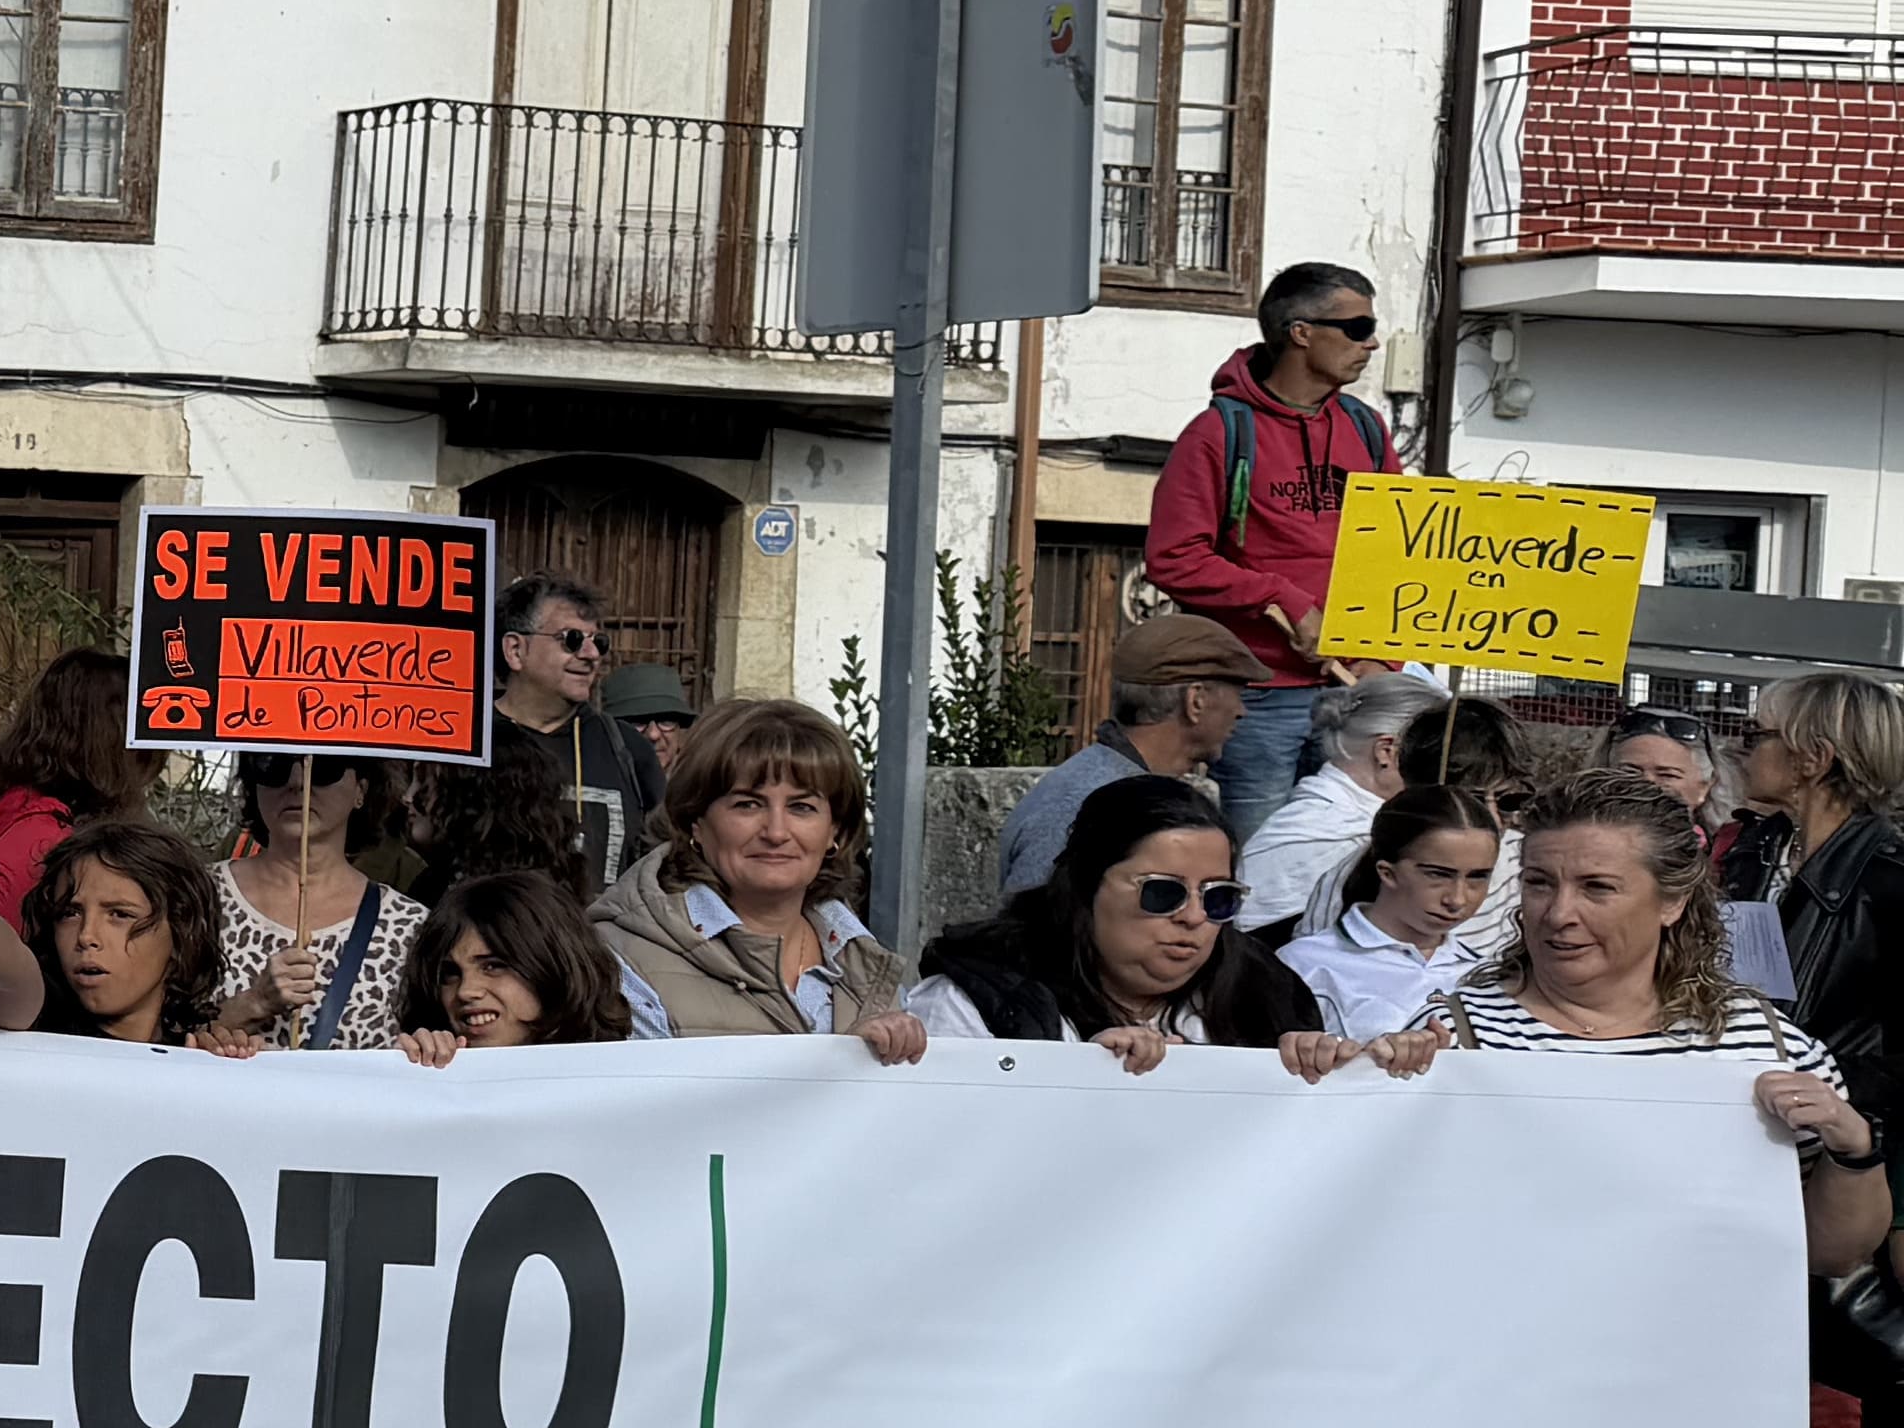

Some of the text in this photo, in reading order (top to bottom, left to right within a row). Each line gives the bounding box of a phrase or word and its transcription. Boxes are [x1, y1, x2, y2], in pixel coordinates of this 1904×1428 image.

[760, 521, 790, 537] ADT
[1396, 498, 1604, 575] Villaverde
[154, 529, 475, 613] SE VENDE
[1468, 570, 1505, 588] en
[1391, 581, 1559, 652] Peligro
[233, 622, 456, 687] Villaverde
[223, 684, 460, 736] de Pontones
